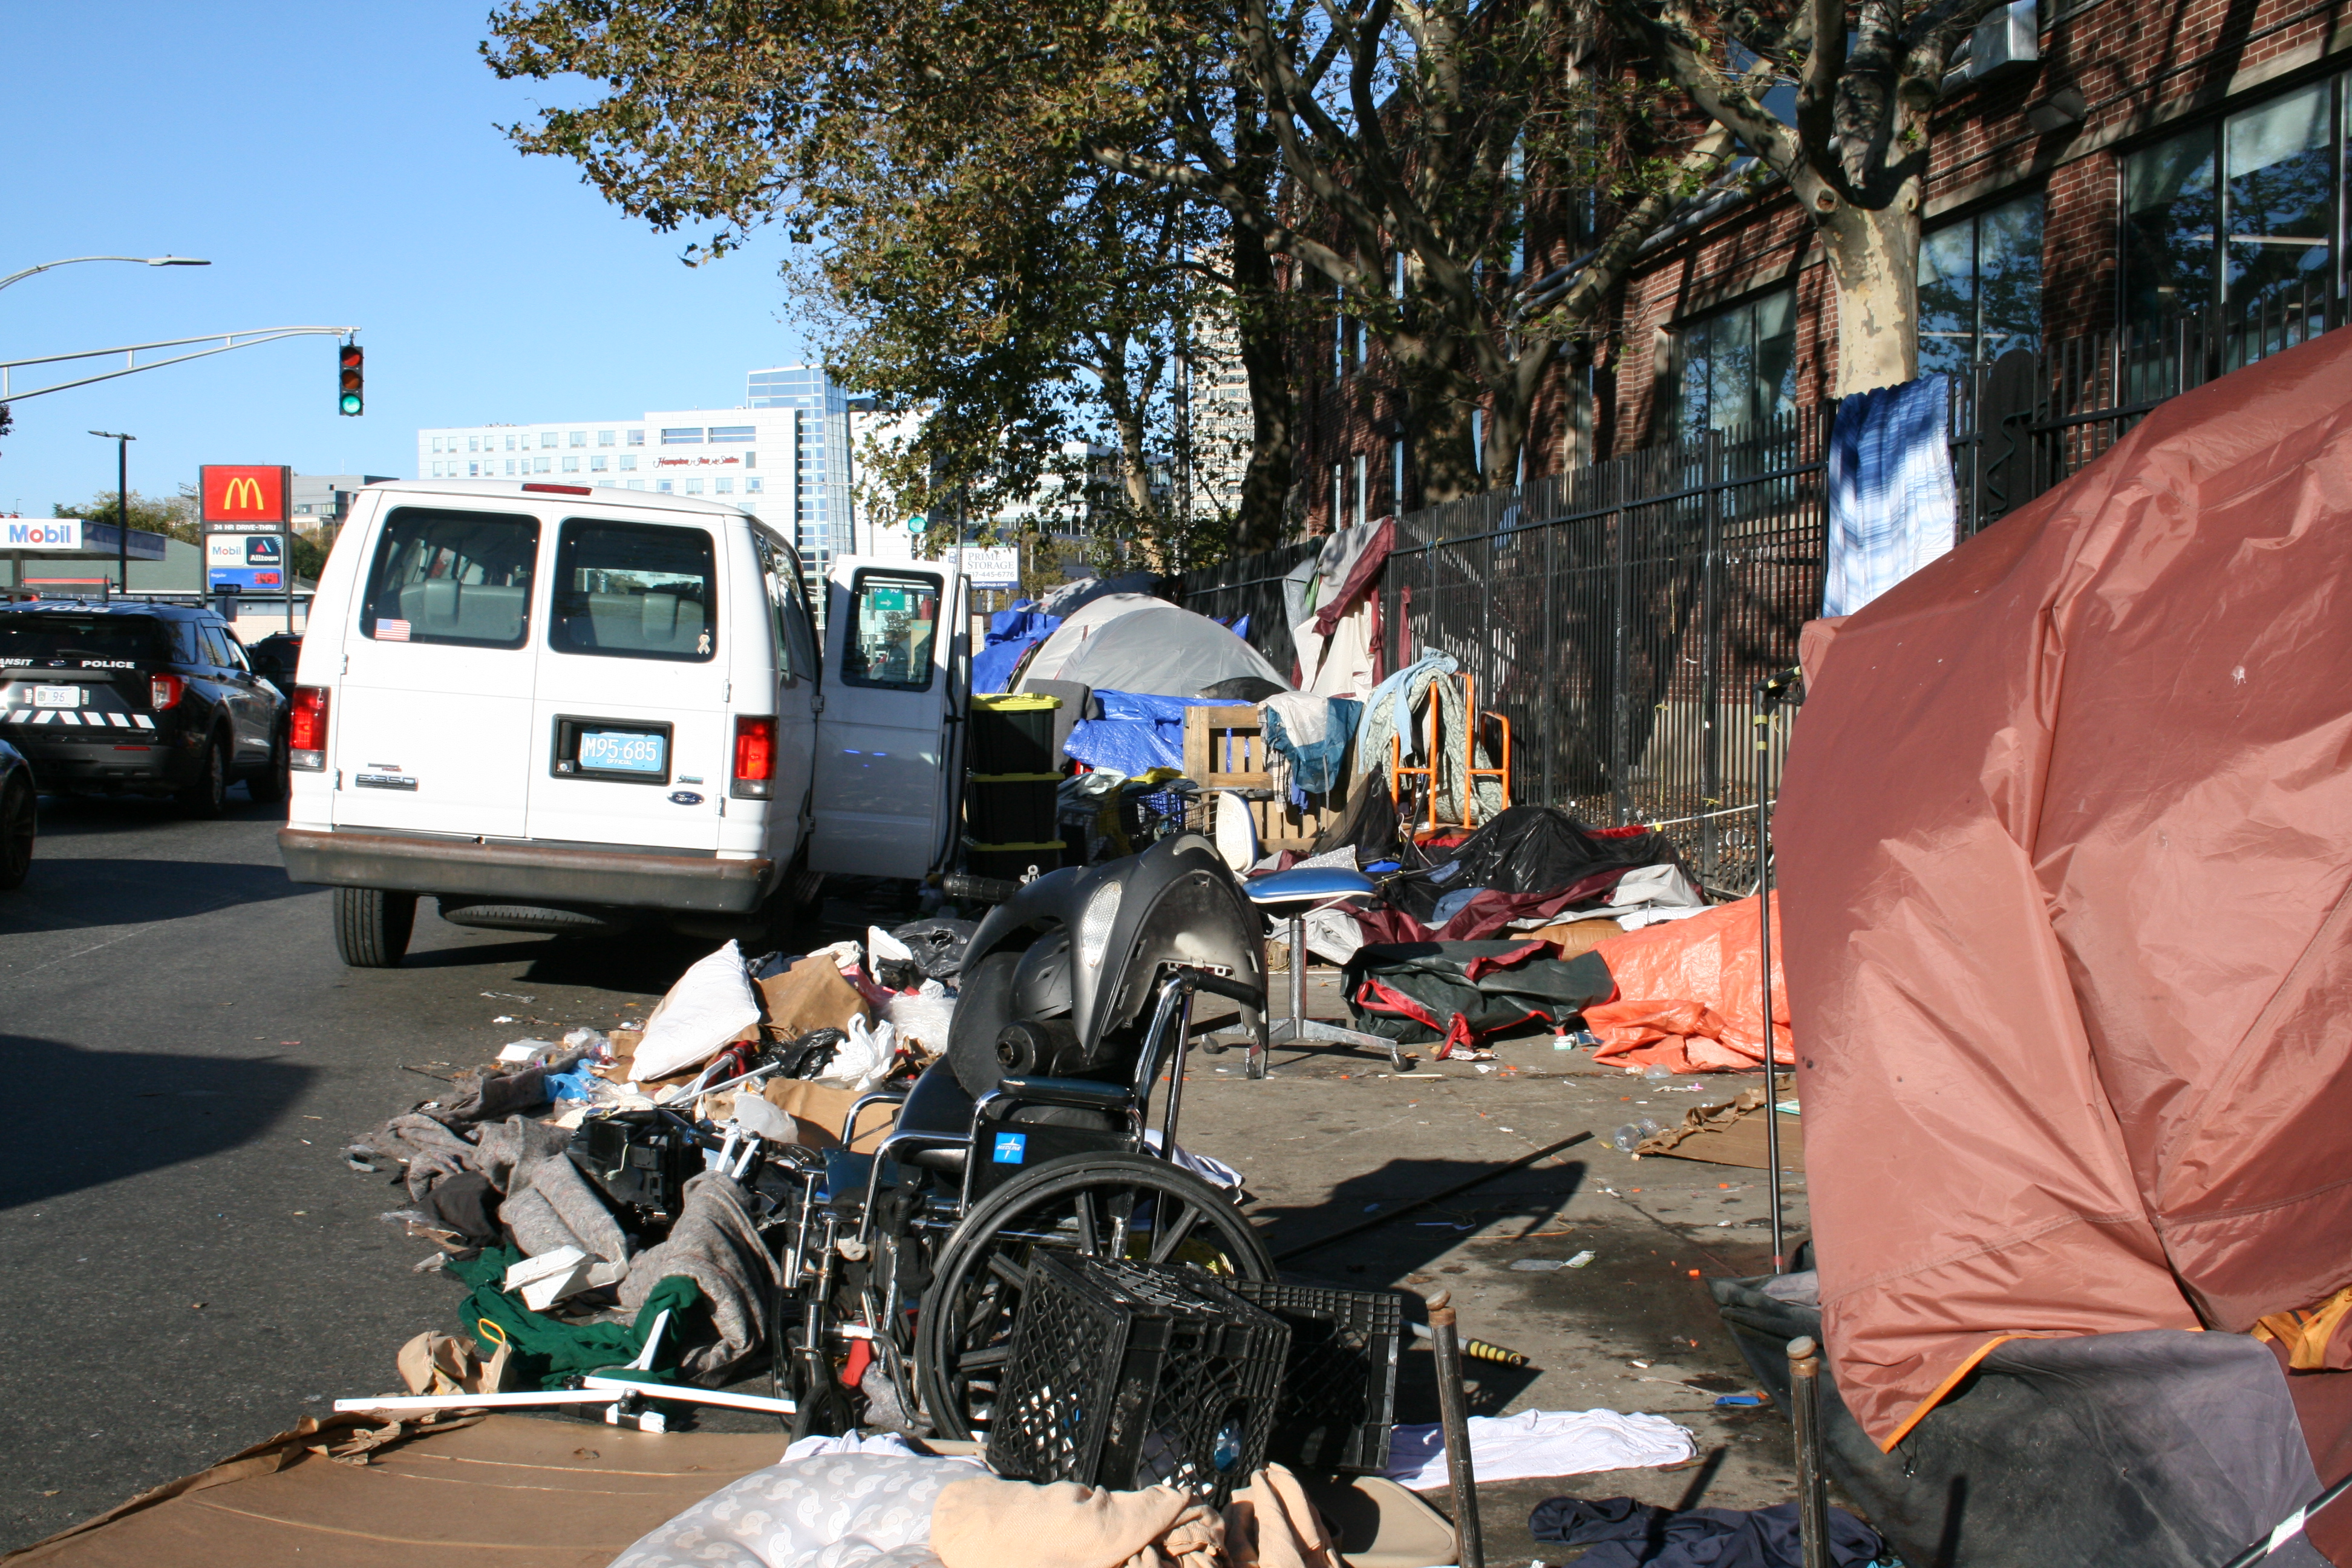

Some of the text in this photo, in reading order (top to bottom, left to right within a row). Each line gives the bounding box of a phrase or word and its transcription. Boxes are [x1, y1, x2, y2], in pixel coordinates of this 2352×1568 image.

[9, 524, 71, 543] Mobil
[212, 546, 241, 555] Mobil
[968, 552, 1001, 560] PRIME
[82, 660, 135, 669] POLICE
[53, 691, 65, 702] 96
